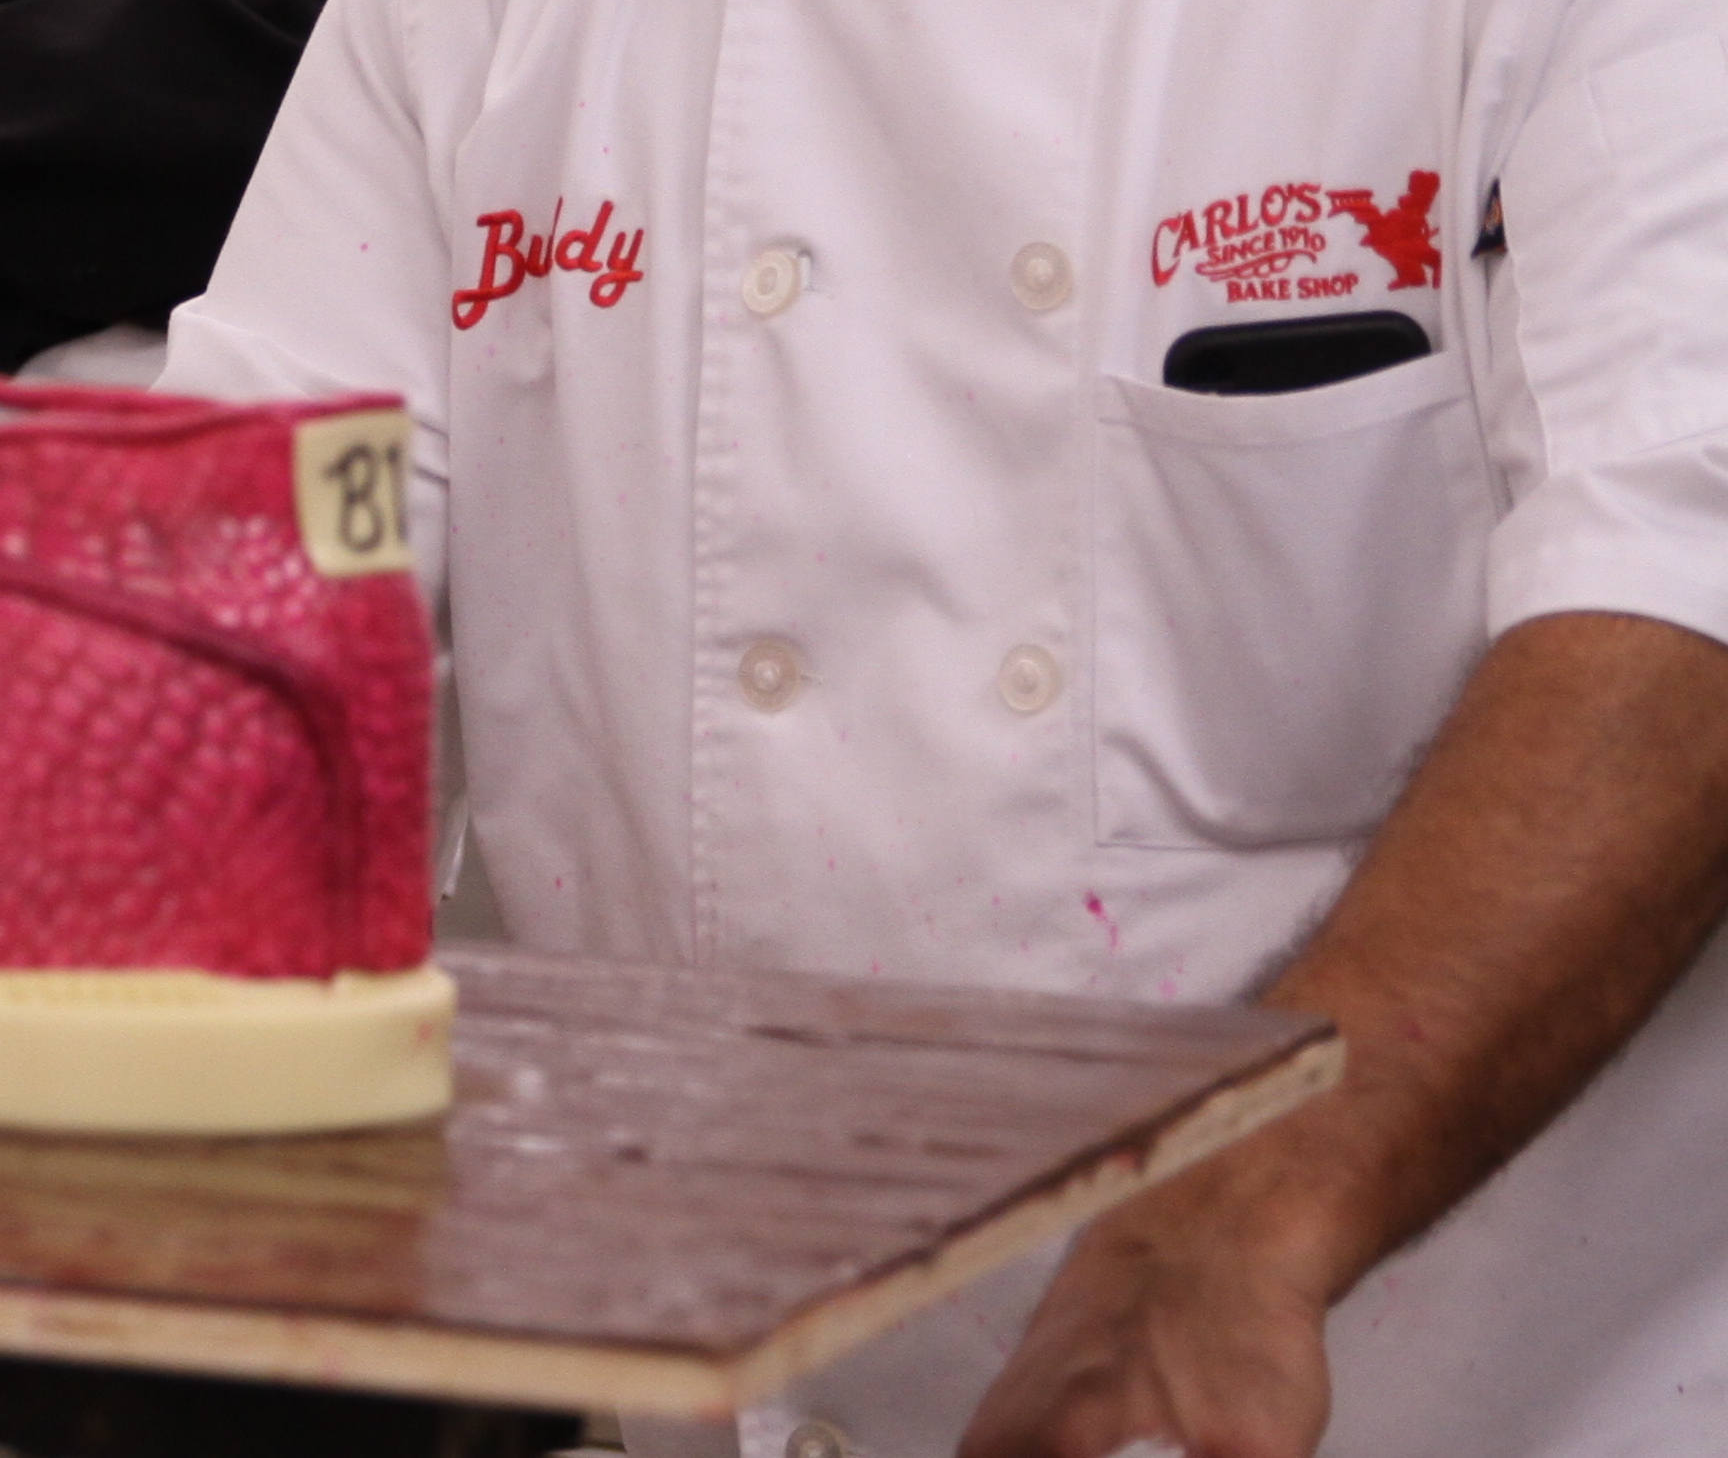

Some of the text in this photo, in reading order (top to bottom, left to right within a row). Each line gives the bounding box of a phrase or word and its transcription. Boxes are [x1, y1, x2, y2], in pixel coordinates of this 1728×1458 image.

[1150, 181, 1322, 288] CARLO'S
[1206, 232, 1274, 267] SINCE
[1226, 273, 1360, 303] BAKE SHOP
